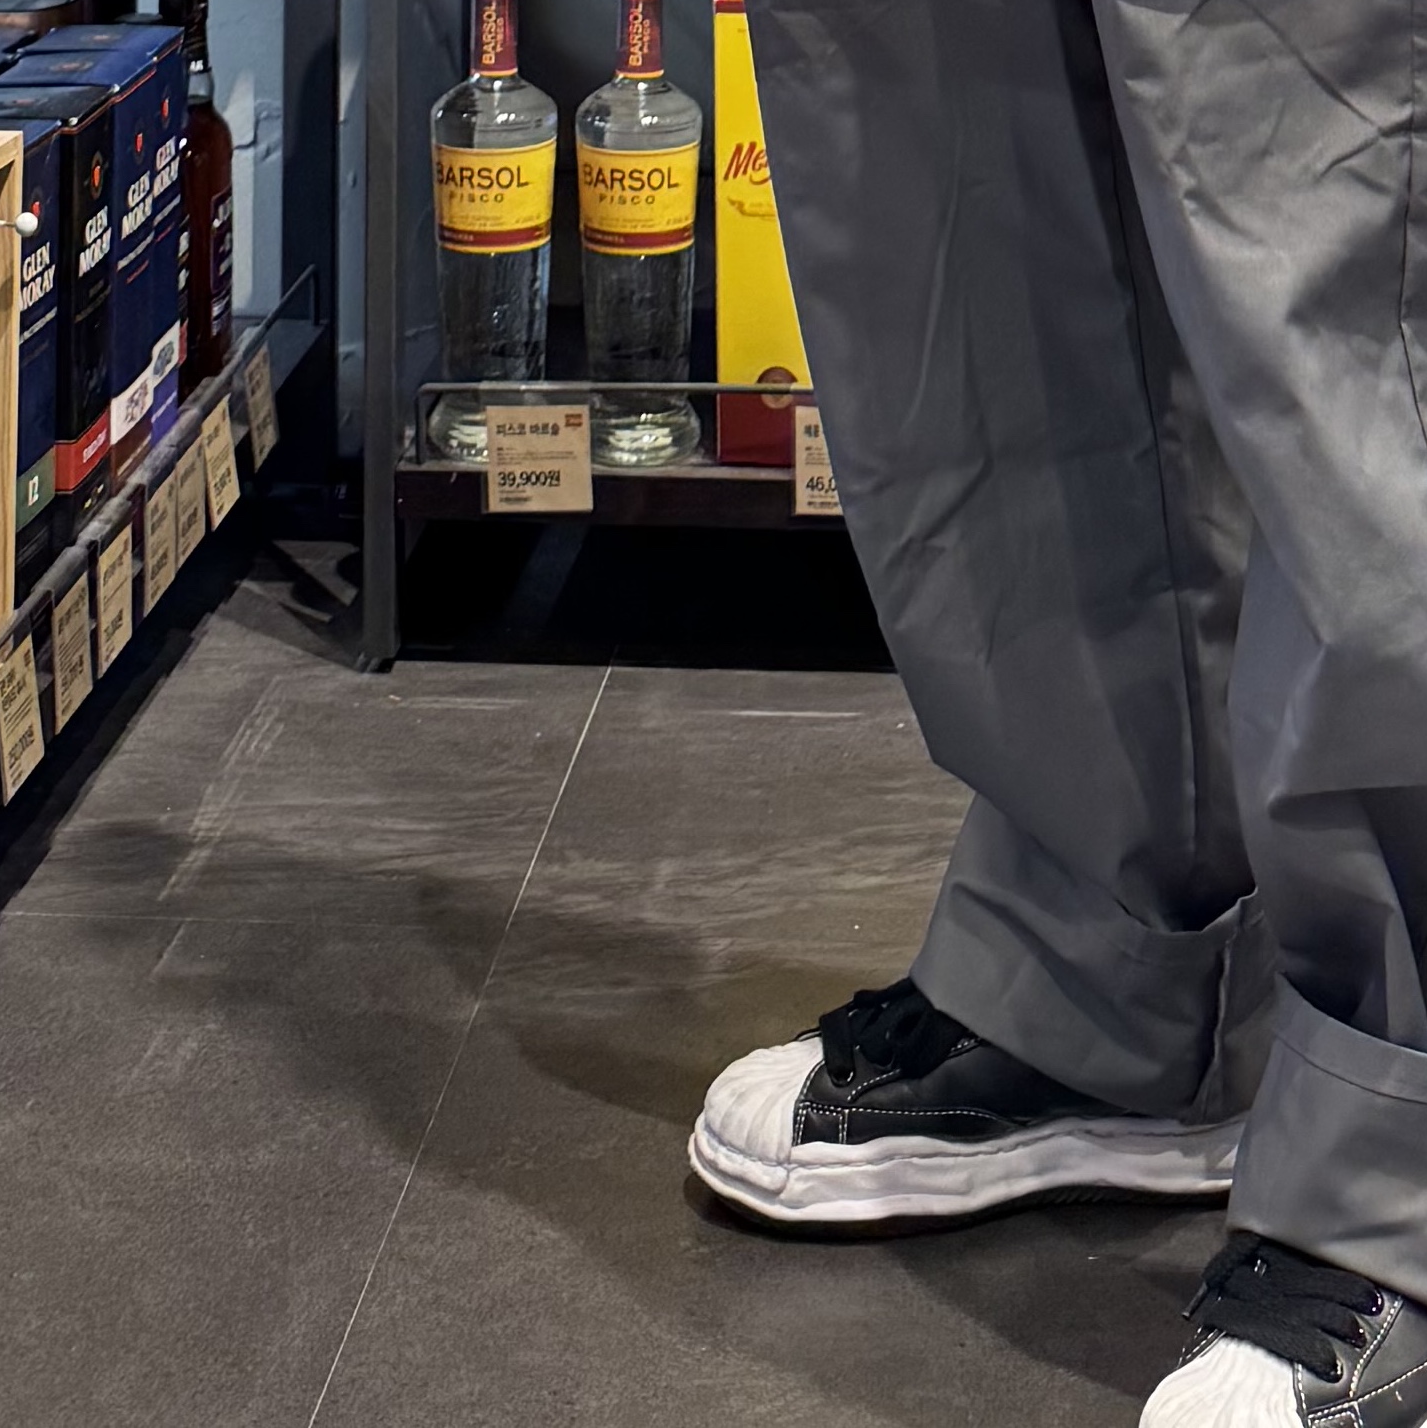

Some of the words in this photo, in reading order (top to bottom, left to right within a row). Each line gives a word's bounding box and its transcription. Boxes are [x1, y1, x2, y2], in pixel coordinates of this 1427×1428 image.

[435, 166, 530, 191] BARSOL
[583, 166, 680, 192] BARSOL
[448, 192, 506, 205] PISCO
[598, 193, 657, 206] PISCO
[22, 241, 51, 282] GLEN
[497, 468, 561, 488] 39,900원
